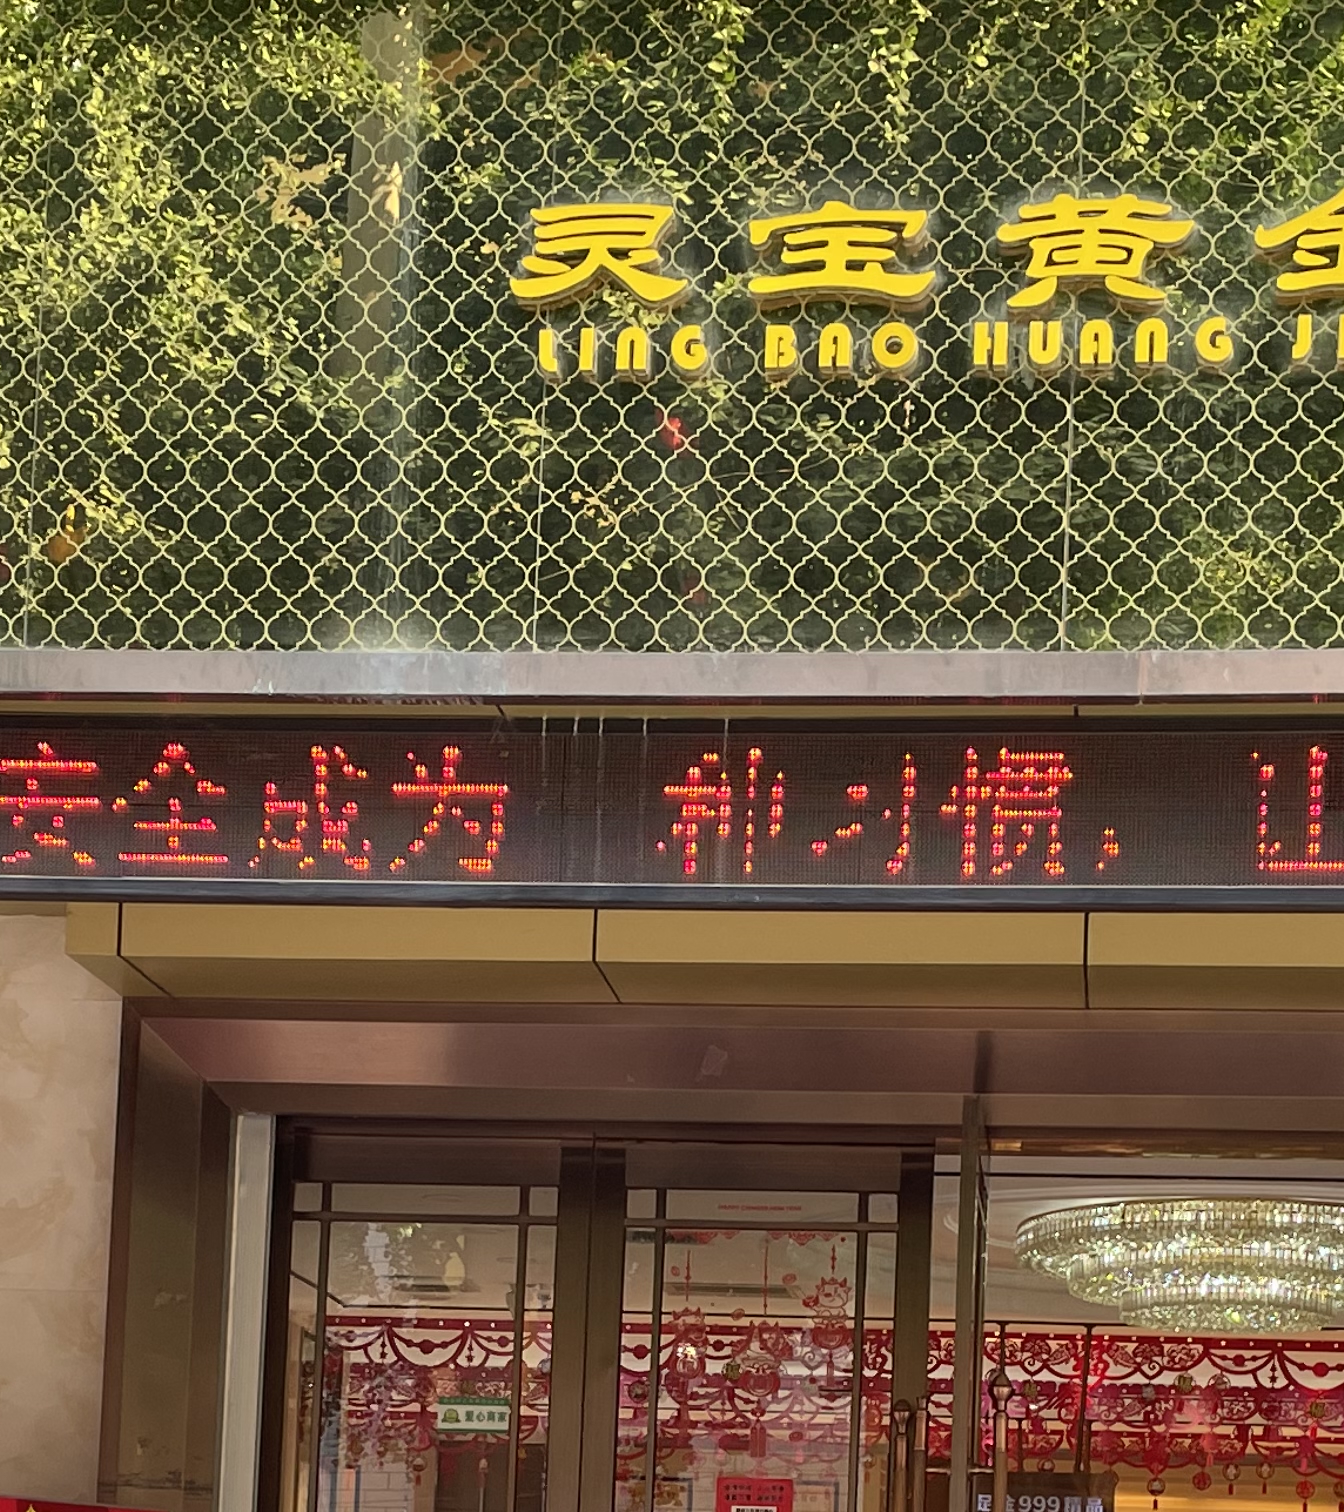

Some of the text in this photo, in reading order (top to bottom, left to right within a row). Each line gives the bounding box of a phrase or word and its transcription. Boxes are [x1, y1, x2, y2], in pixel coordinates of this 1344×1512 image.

[539, 324, 708, 374] LING
[765, 322, 918, 371] BAO
[973, 315, 1233, 366] HUANG
